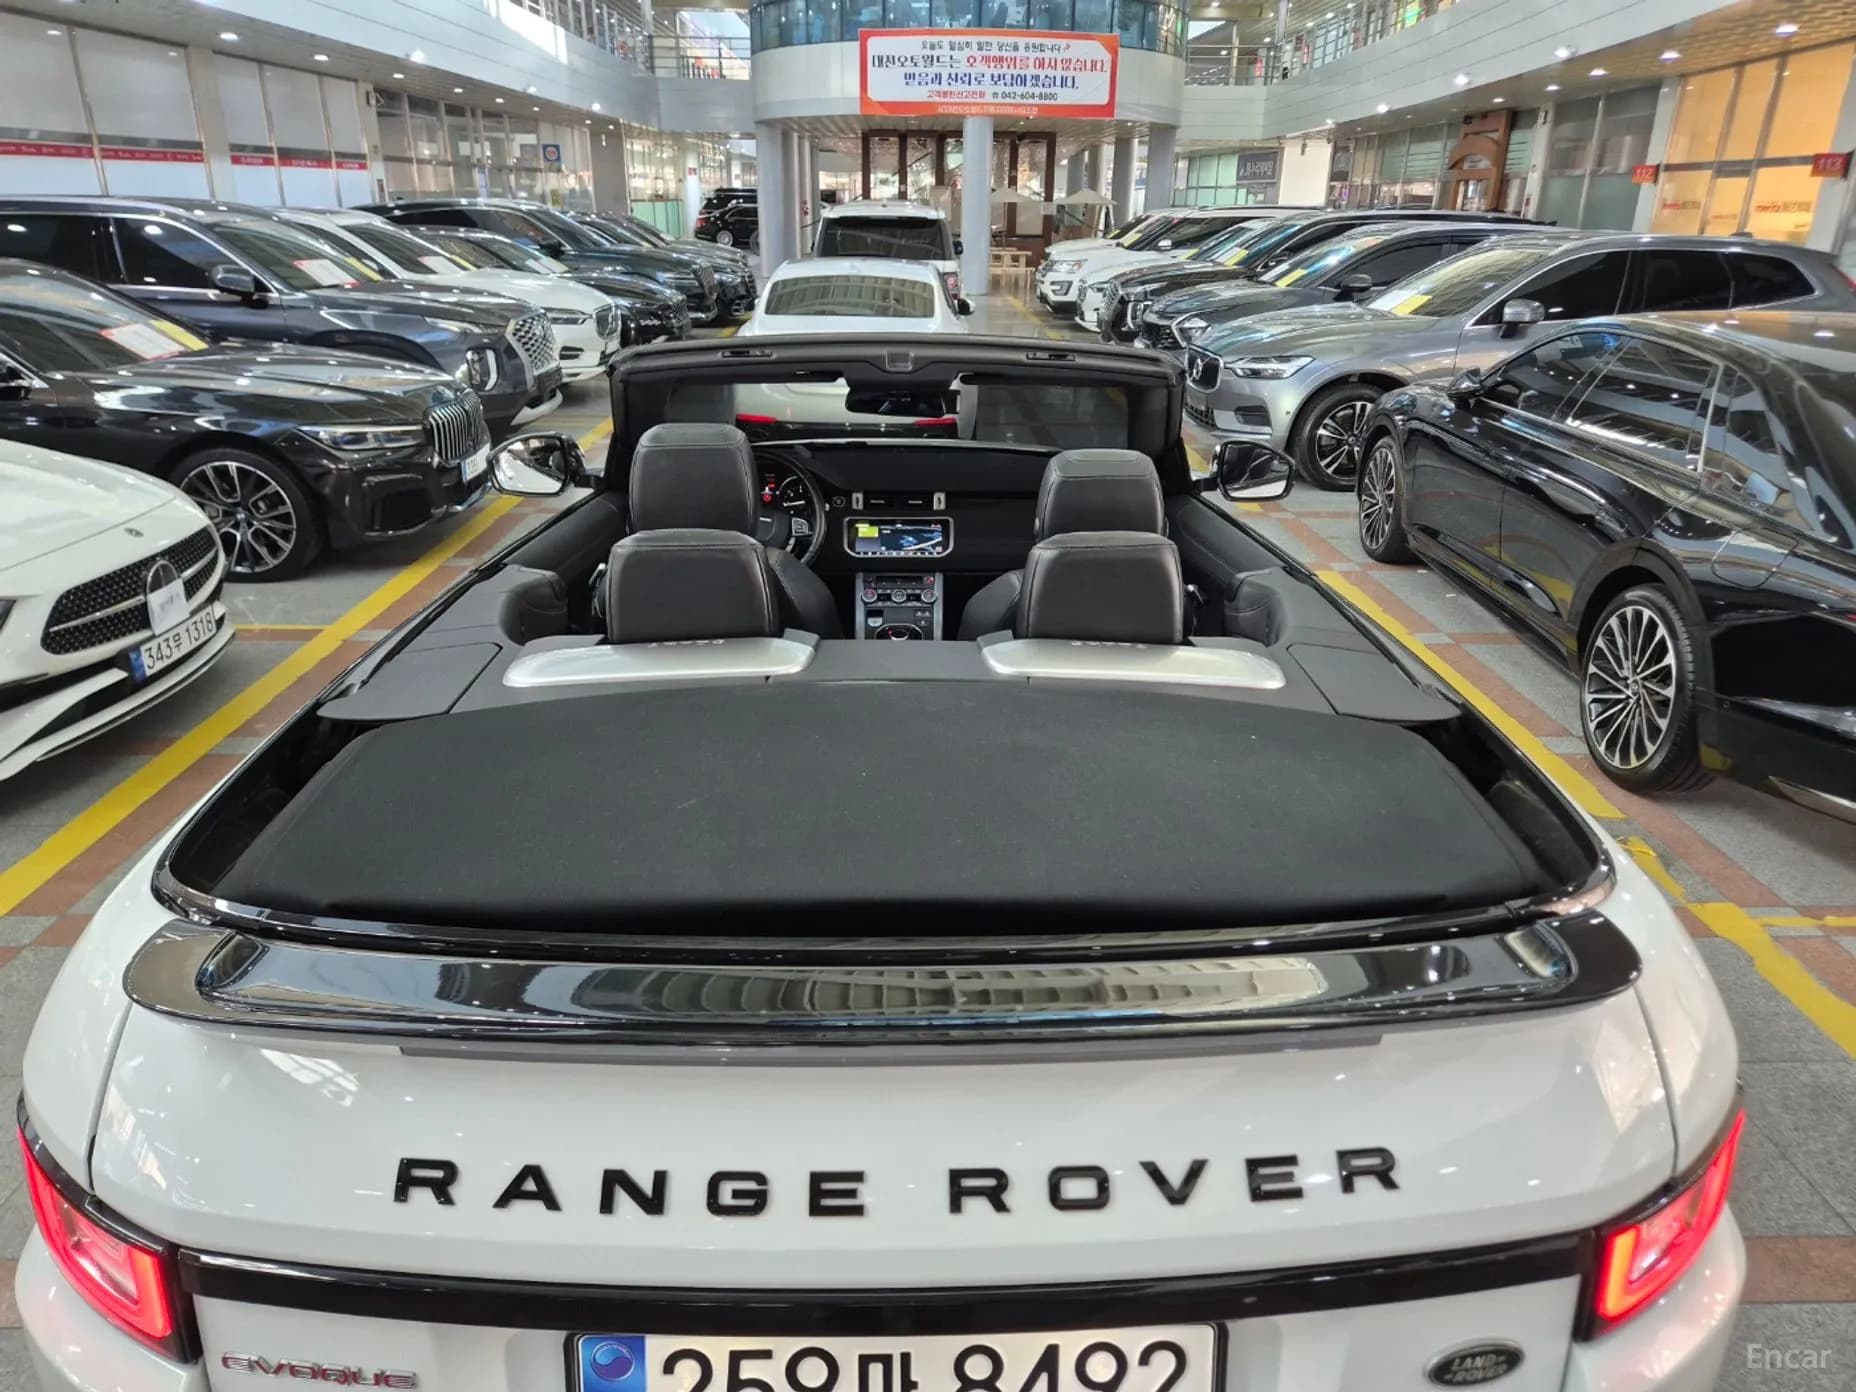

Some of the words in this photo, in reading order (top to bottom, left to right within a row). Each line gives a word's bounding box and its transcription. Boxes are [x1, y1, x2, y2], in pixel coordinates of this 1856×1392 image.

[921, 40, 945, 50] 오늘도
[997, 41, 1020, 52] 당신을
[1023, 42, 1061, 54] 응원합니다
[872, 54, 961, 69] 대전오토월드는
[966, 54, 1030, 70] 호객행위를
[1033, 56, 1058, 71] 하지
[1060, 57, 1107, 73] 않습니다.
[903, 72, 942, 87] 믿음과
[946, 72, 985, 87] 신뢰로
[990, 73, 1079, 90] 보답하겠습니다.
[185, 611, 214, 646] 1318
[393, 1156, 866, 1217] RANGE
[948, 1146, 1401, 1214] ROVER
